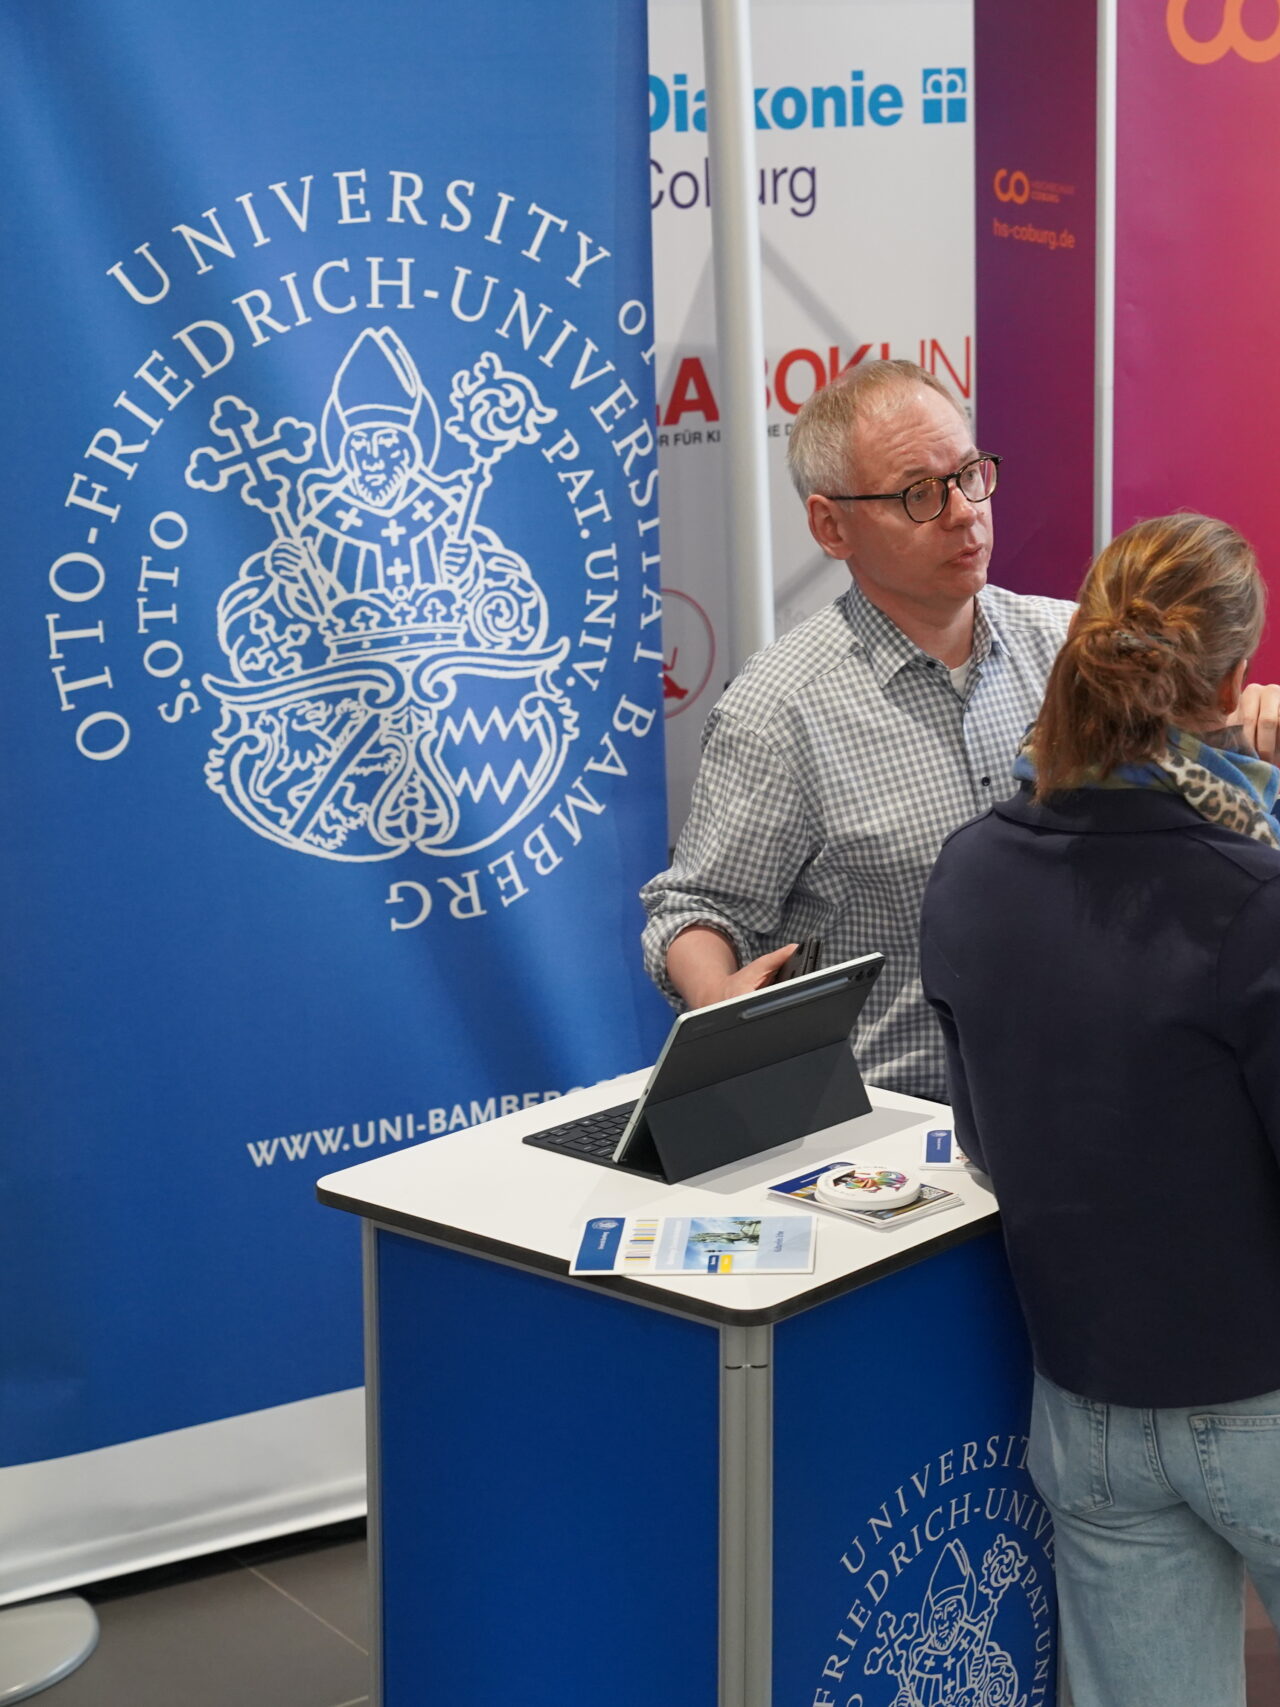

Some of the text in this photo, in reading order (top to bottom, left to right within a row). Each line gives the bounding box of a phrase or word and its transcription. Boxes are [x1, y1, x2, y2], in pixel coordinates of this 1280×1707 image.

[649, 70, 904, 132] Dionie
[106, 168, 611, 306] UNIVERSITY
[674, 430, 703, 447] FÜR
[384, 694, 657, 932] BAMBERG
[839, 1434, 1030, 1574] UNIVERSIT
